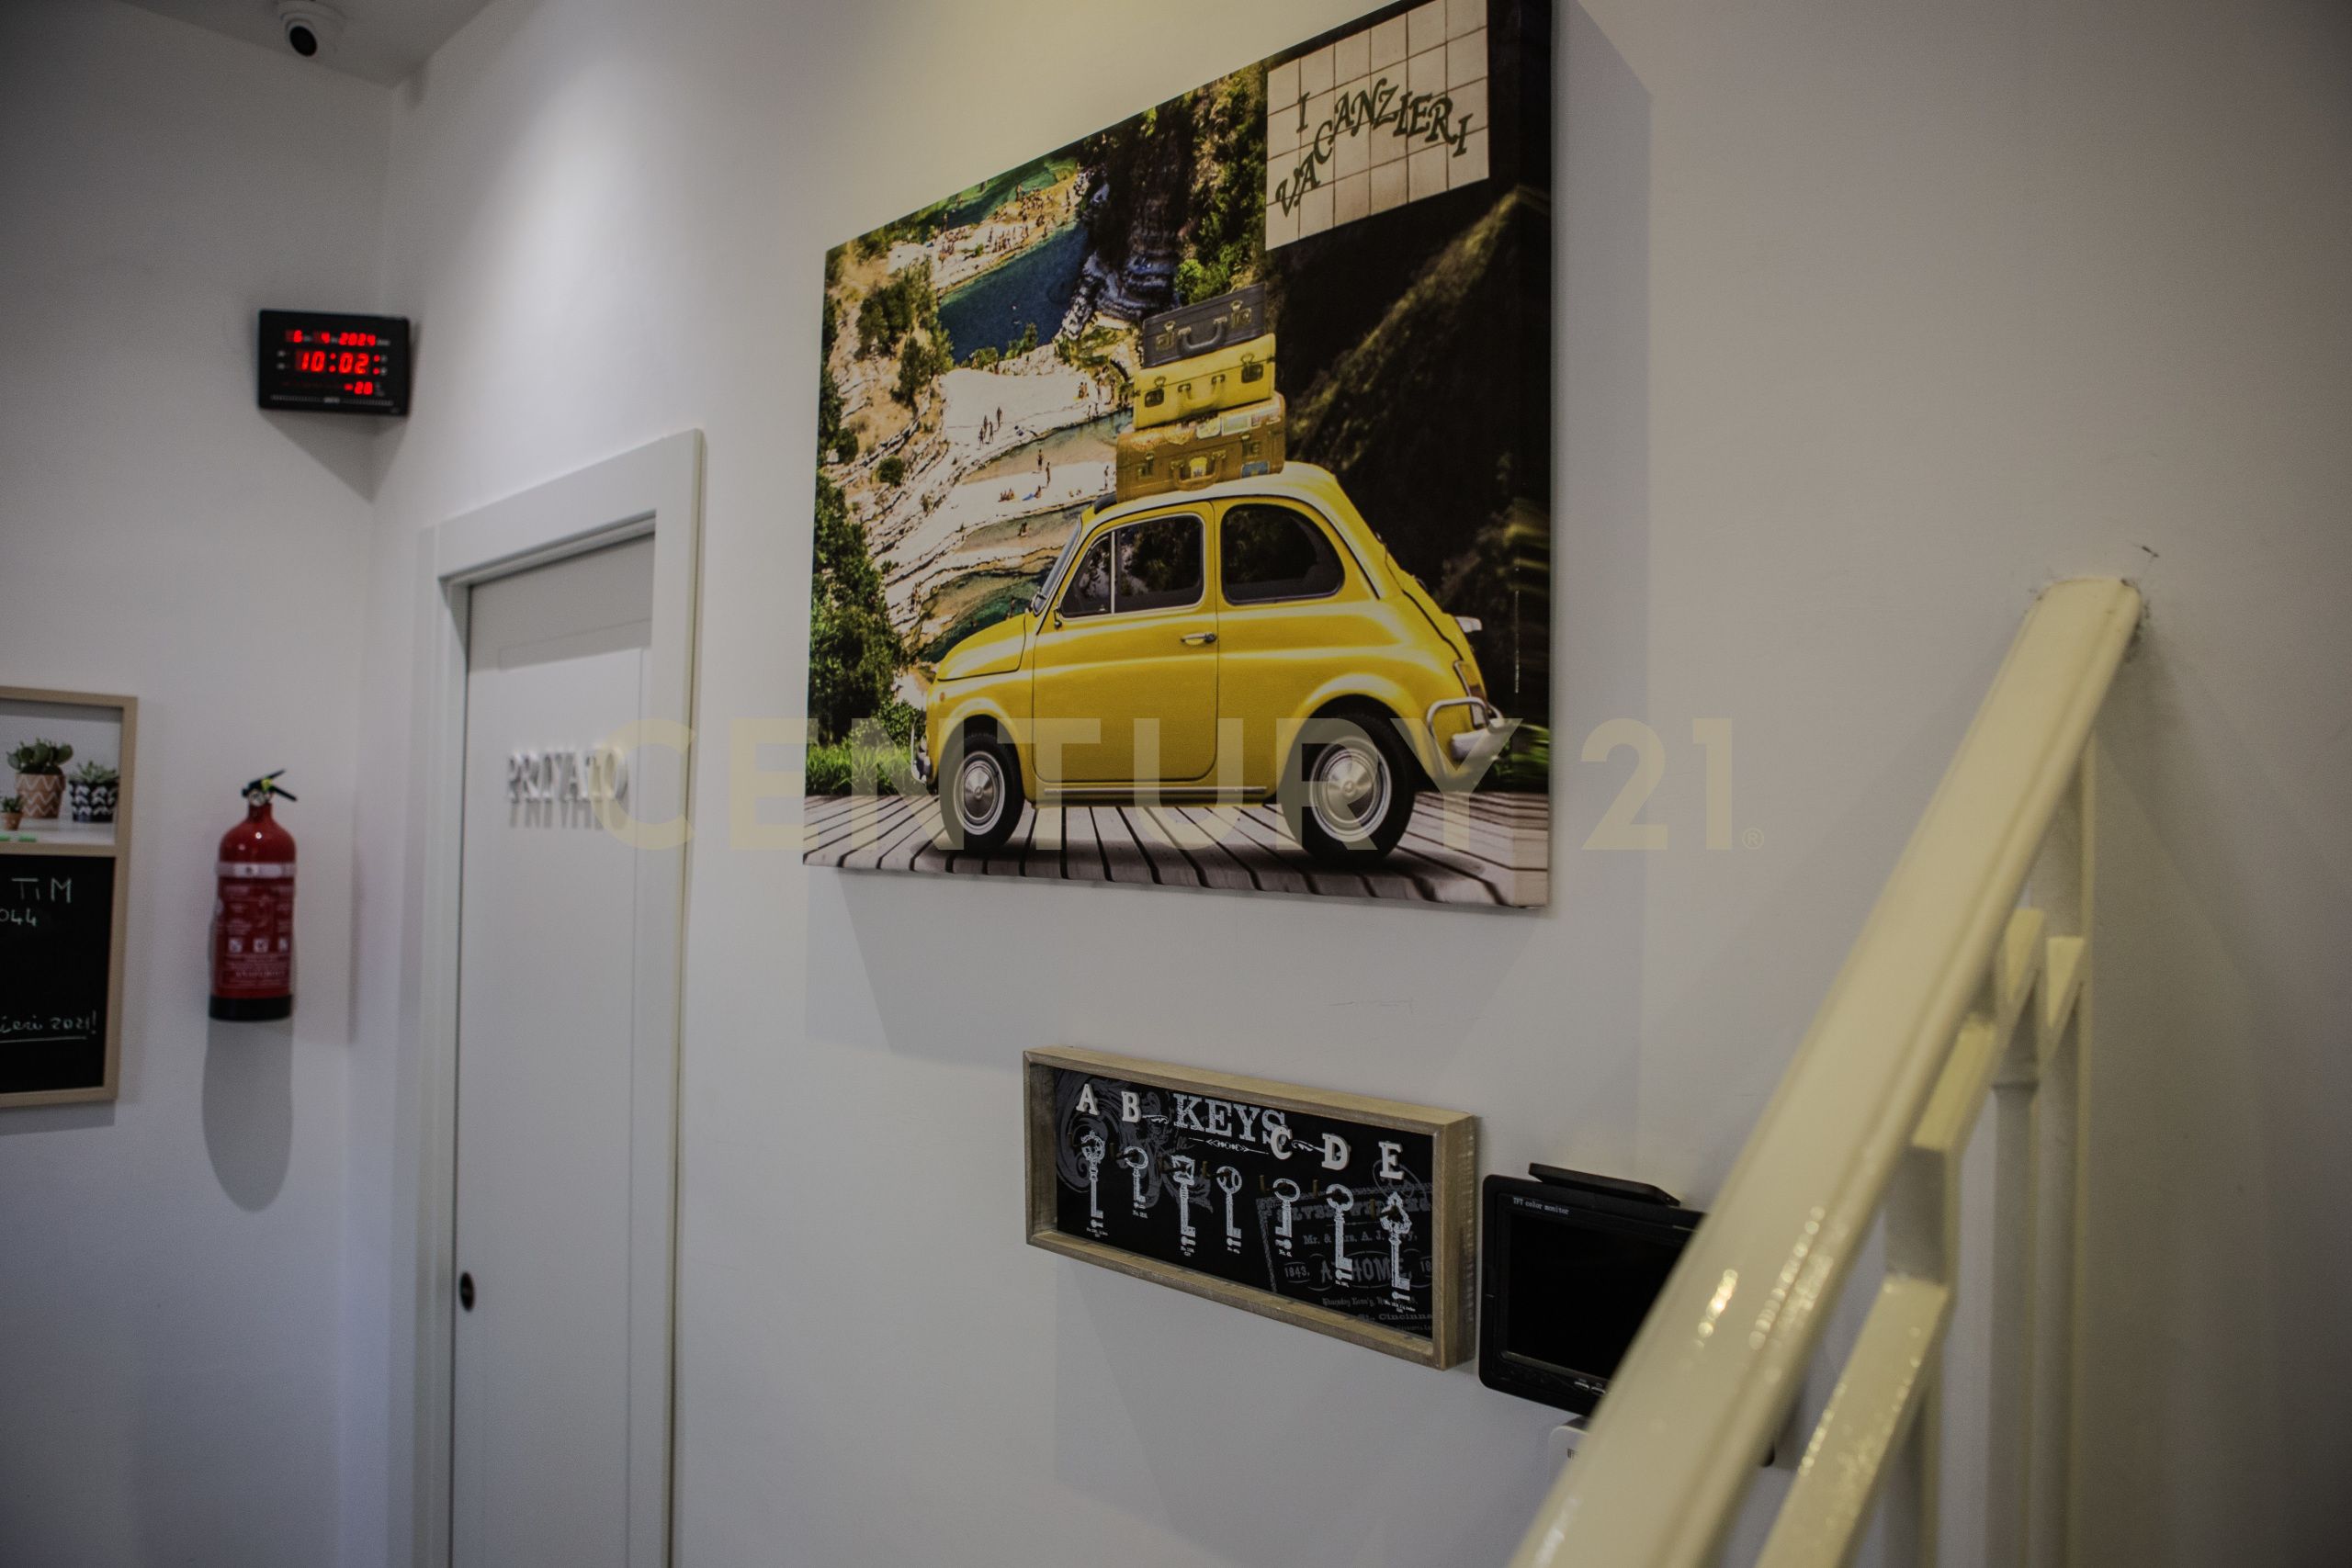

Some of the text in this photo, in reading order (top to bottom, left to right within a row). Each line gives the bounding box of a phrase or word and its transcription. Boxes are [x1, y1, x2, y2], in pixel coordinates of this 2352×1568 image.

[1295, 91, 1310, 134] I
[1275, 77, 1474, 218] VACANZIERI
[300, 350, 370, 376] 10:02
[1076, 1083, 1405, 1180] A B C D E
[1172, 1092, 1286, 1145] KEYS
[1512, 1196, 1570, 1215] TFT color monitor
